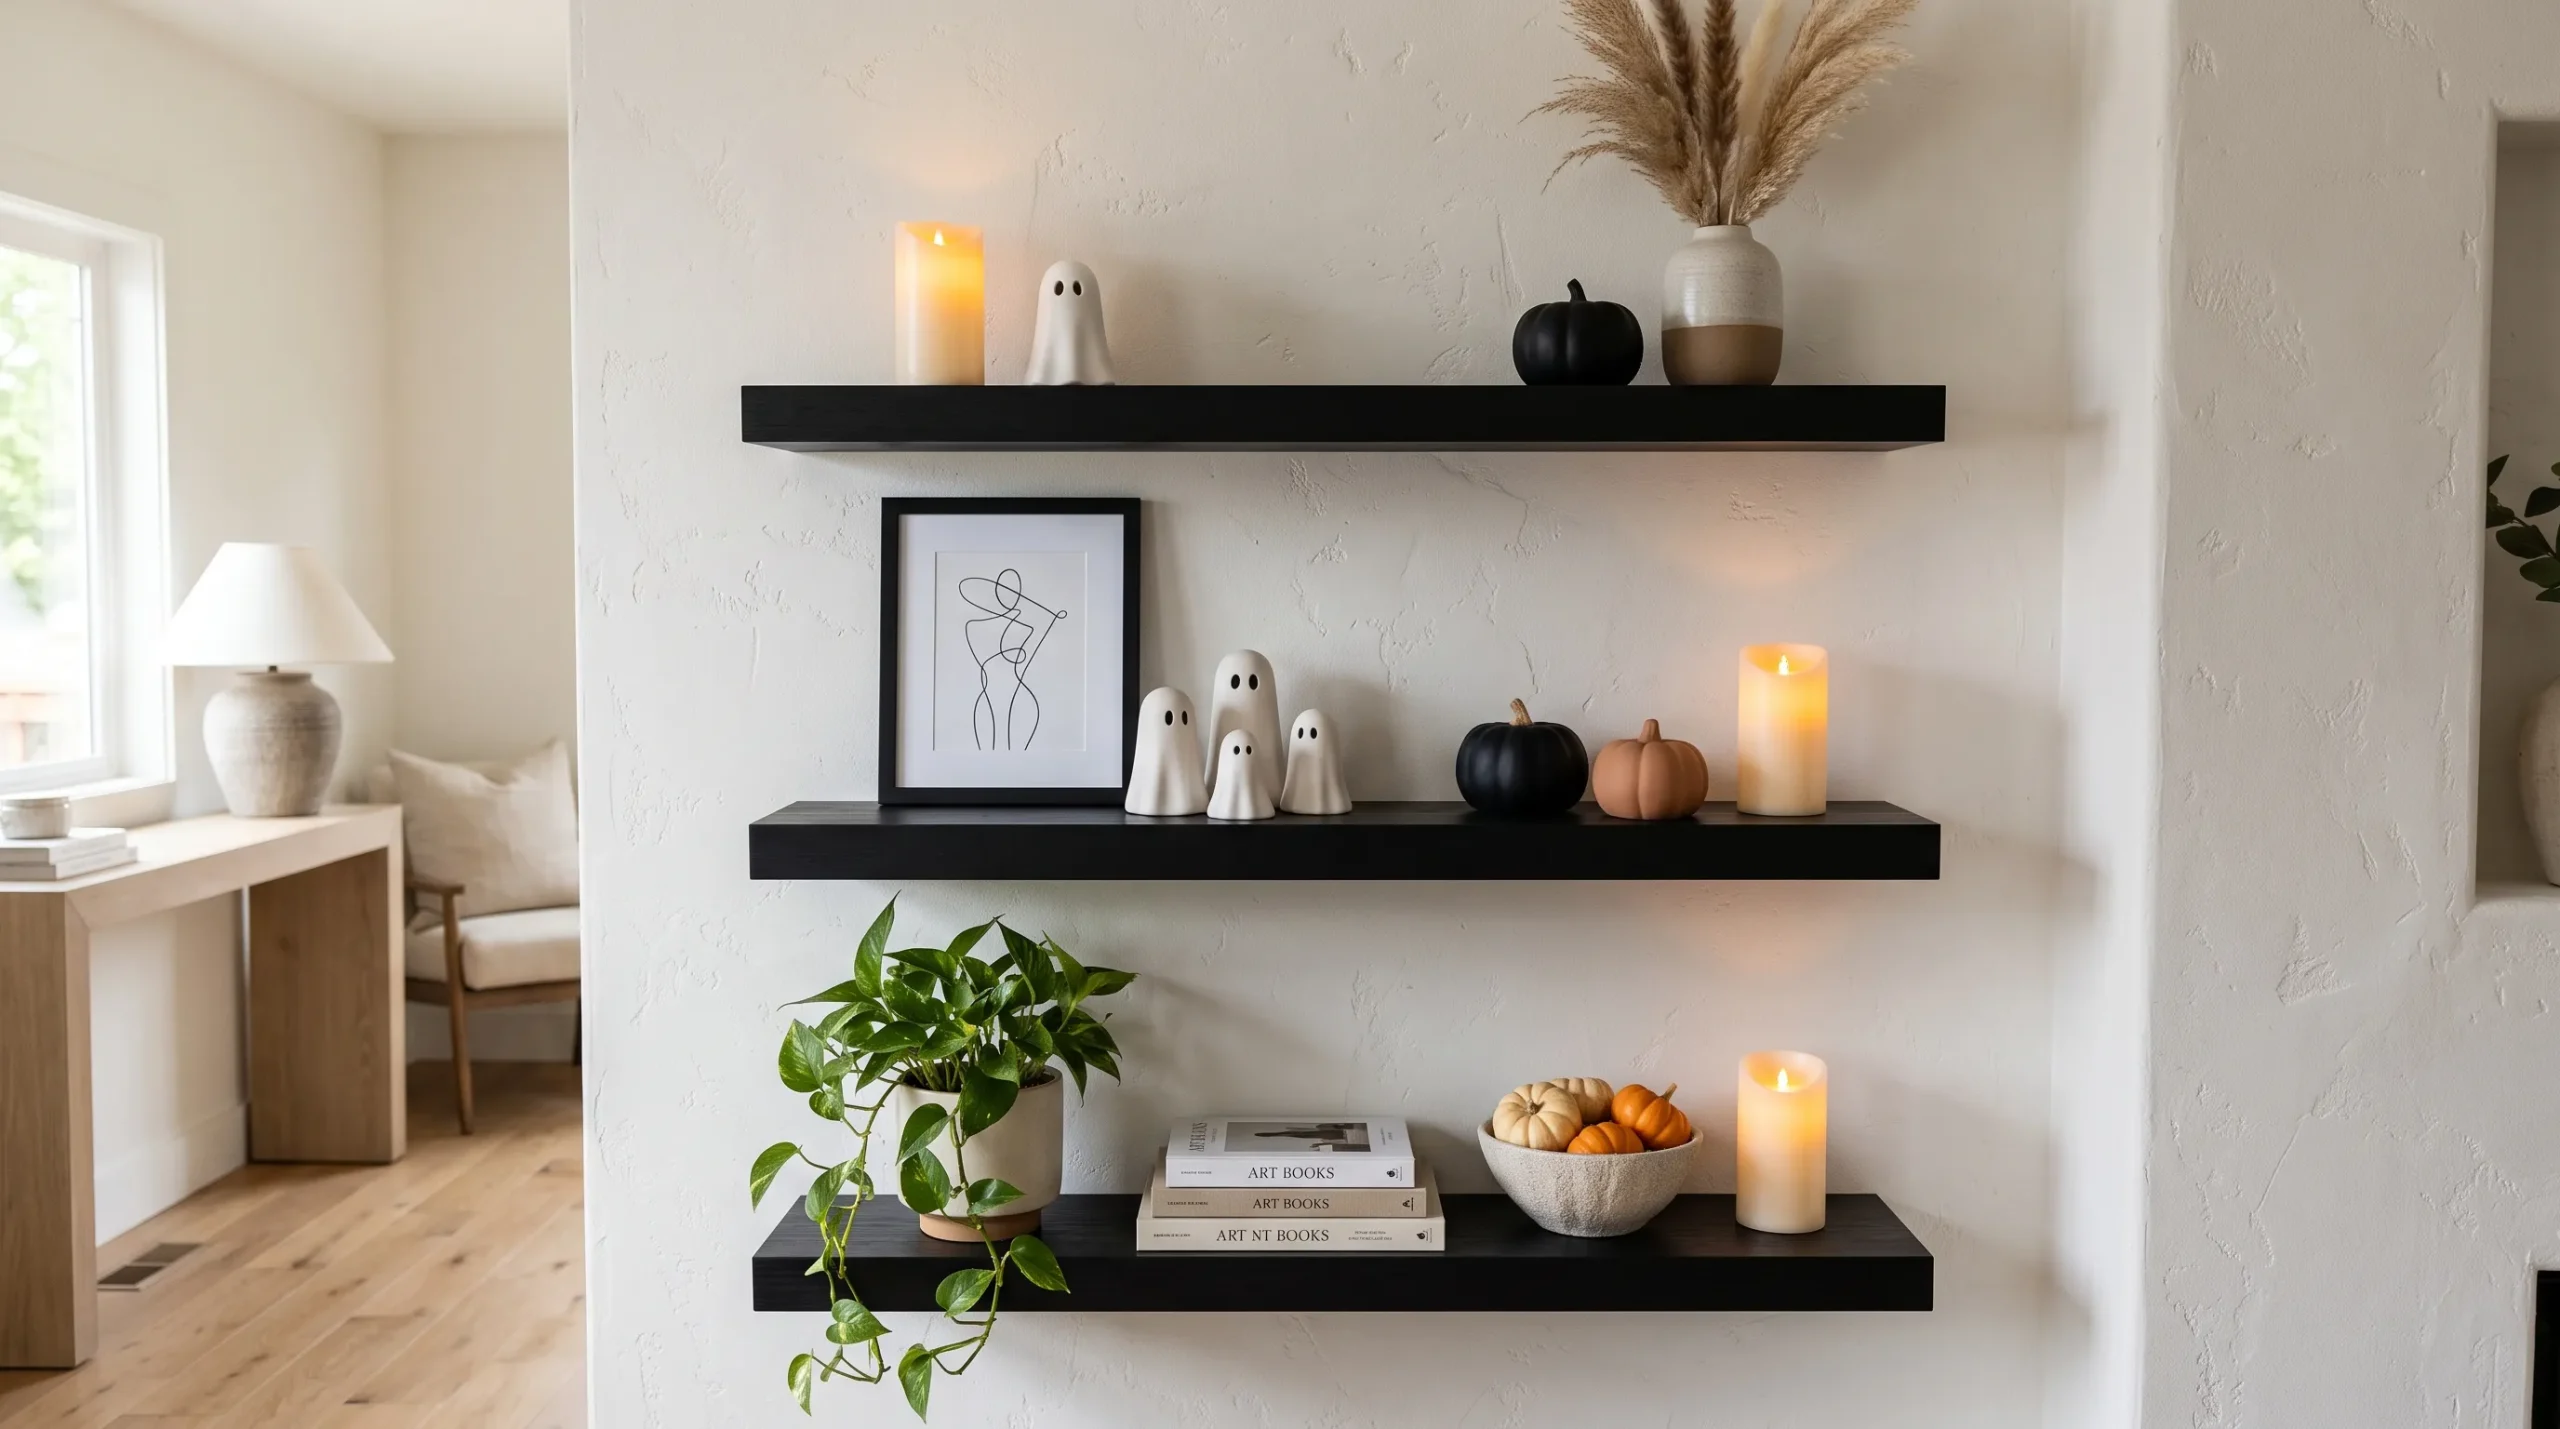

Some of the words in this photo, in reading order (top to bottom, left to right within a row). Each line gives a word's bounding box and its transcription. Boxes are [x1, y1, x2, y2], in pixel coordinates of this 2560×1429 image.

[1248, 1166, 1278, 1179] ART
[1283, 1166, 1335, 1180] BOOKS
[1253, 1198, 1279, 1209] ART
[1283, 1198, 1330, 1209] BOOKS
[1216, 1229, 1247, 1242] ART
[1251, 1229, 1272, 1242] NT
[1277, 1229, 1330, 1242] BOOKS
